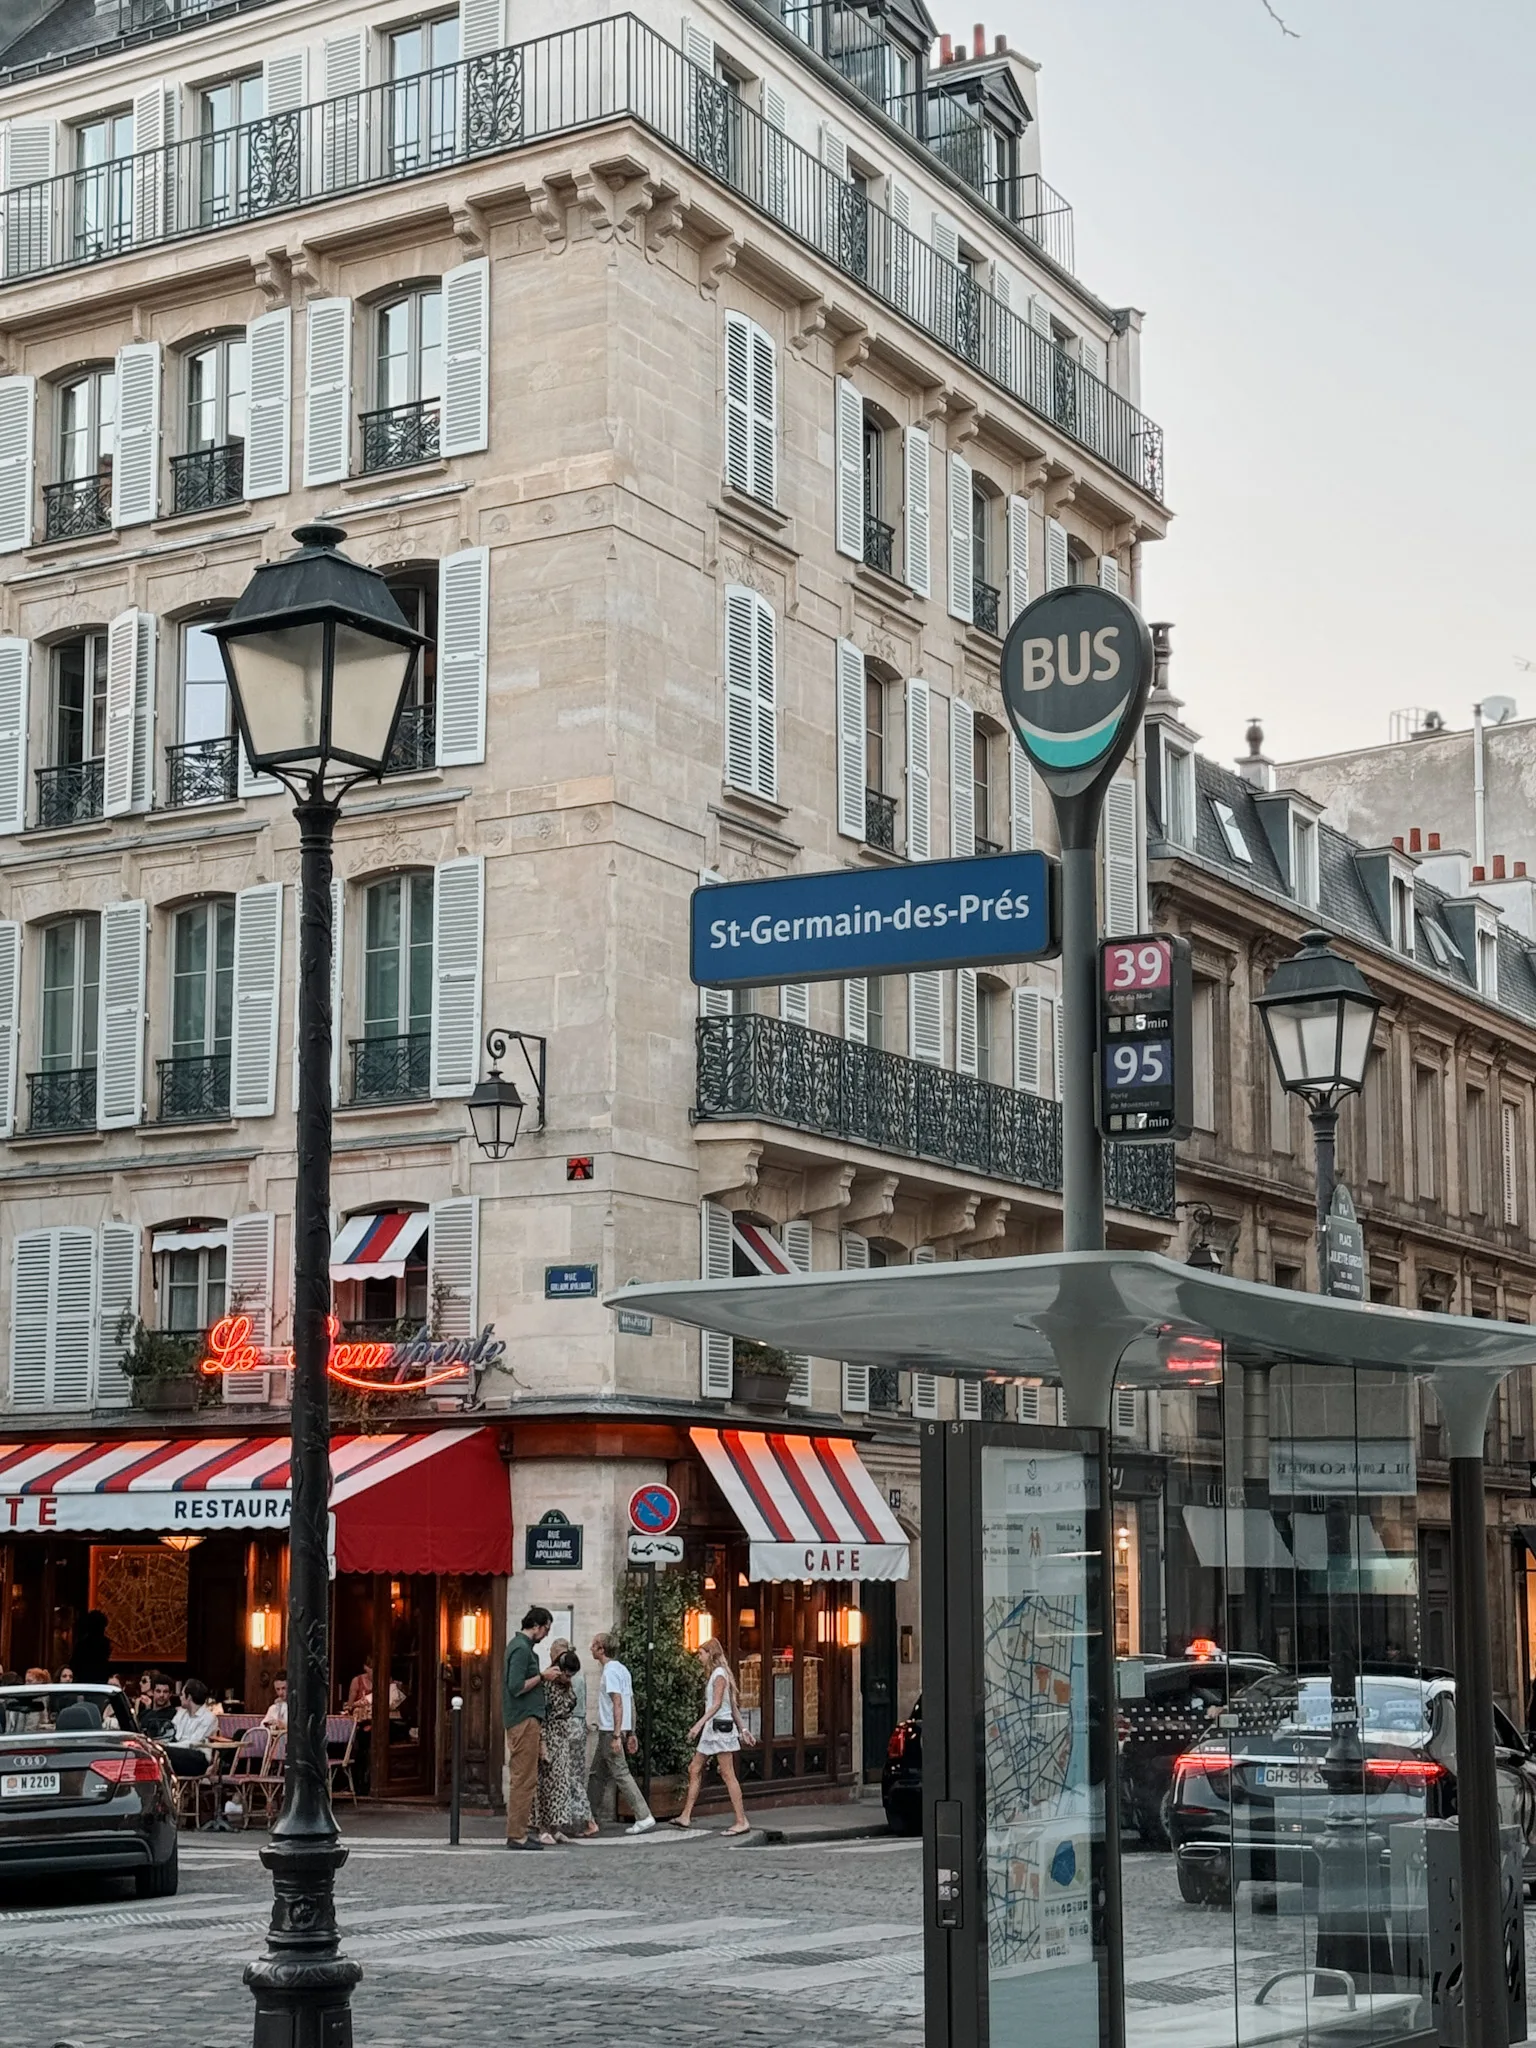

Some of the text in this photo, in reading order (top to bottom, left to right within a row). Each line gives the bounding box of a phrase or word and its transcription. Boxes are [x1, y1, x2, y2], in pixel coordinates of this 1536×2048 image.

[1022, 626, 1120, 691] BUS
[710, 889, 1030, 949] St-Germain-des-Prés
[1113, 946, 1163, 987] 39
[1135, 1014, 1168, 1031] 5 min
[1113, 1044, 1163, 1085] 95
[1137, 1113, 1169, 1130] 7 min
[564, 1273, 577, 1281] RUE
[202, 1315, 257, 1373] Le
[927, 1424, 935, 1435] 6
[951, 1422, 964, 1434] 51
[547, 1530, 560, 1539] RUE
[536, 1540, 571, 1549] GUILLAUME
[535, 1550, 572, 1559] APOLLINAIRE
[804, 1549, 860, 1572] CAFE
[30, 1775, 56, 1789] 2209
